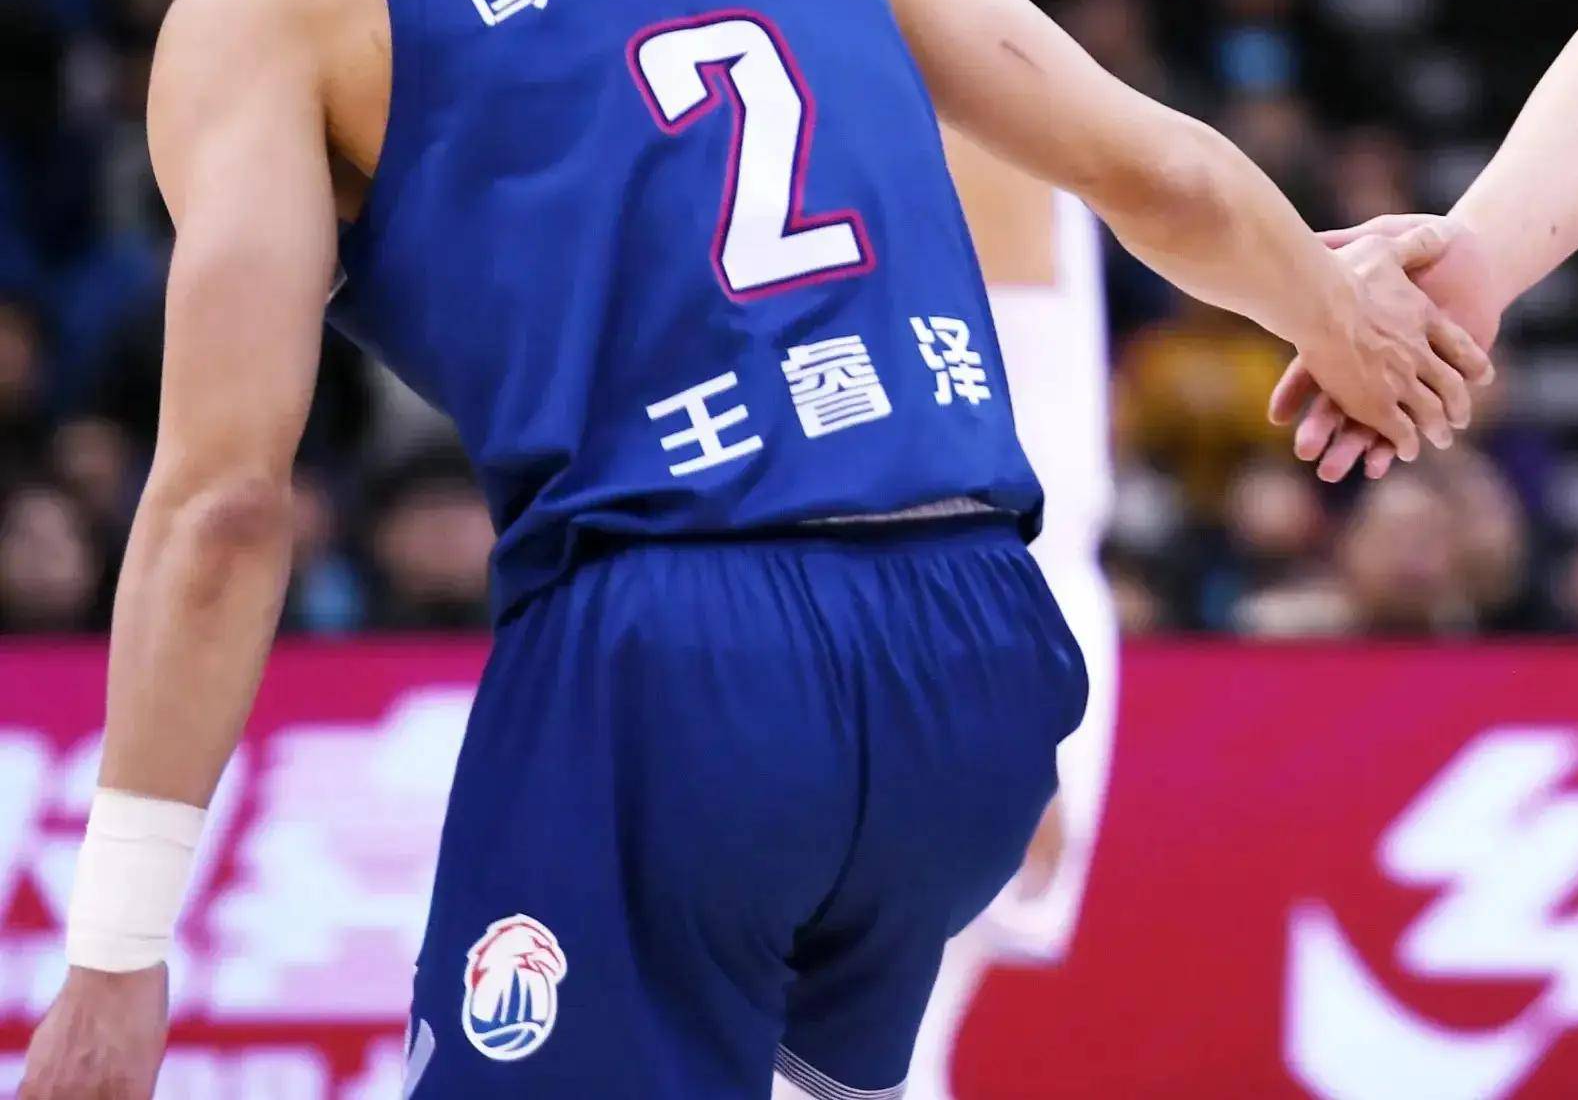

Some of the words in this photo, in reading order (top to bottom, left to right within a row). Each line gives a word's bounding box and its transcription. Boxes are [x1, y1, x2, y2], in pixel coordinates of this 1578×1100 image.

[627, 9, 876, 303] 2
[646, 316, 992, 478] 王睿泽
